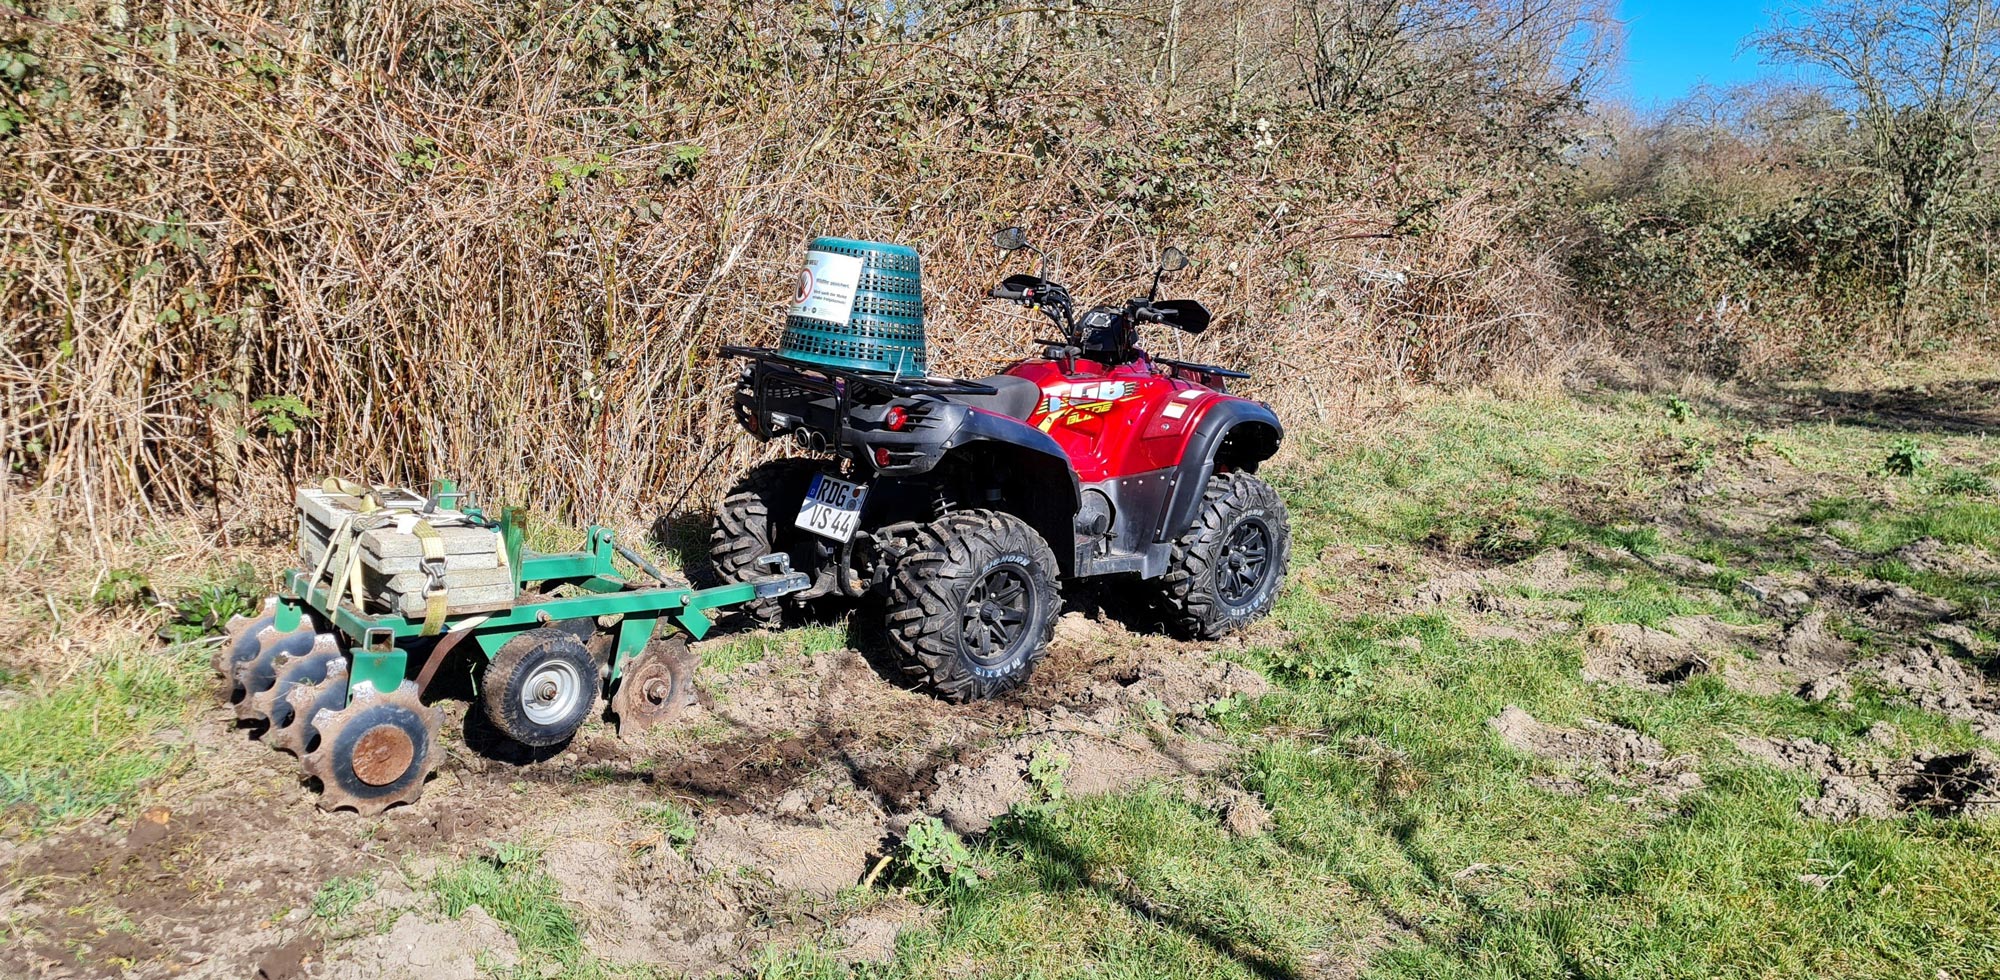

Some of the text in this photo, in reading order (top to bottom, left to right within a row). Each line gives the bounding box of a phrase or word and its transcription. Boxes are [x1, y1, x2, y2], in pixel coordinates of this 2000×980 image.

[1066, 403, 1113, 425] BLADE
[816, 478, 850, 508] RDG
[809, 504, 852, 537] VS 44
[982, 554, 1031, 574] BIGHORN
[1231, 591, 1267, 616] MAXXIS
[975, 657, 1022, 678] MAXXIS
